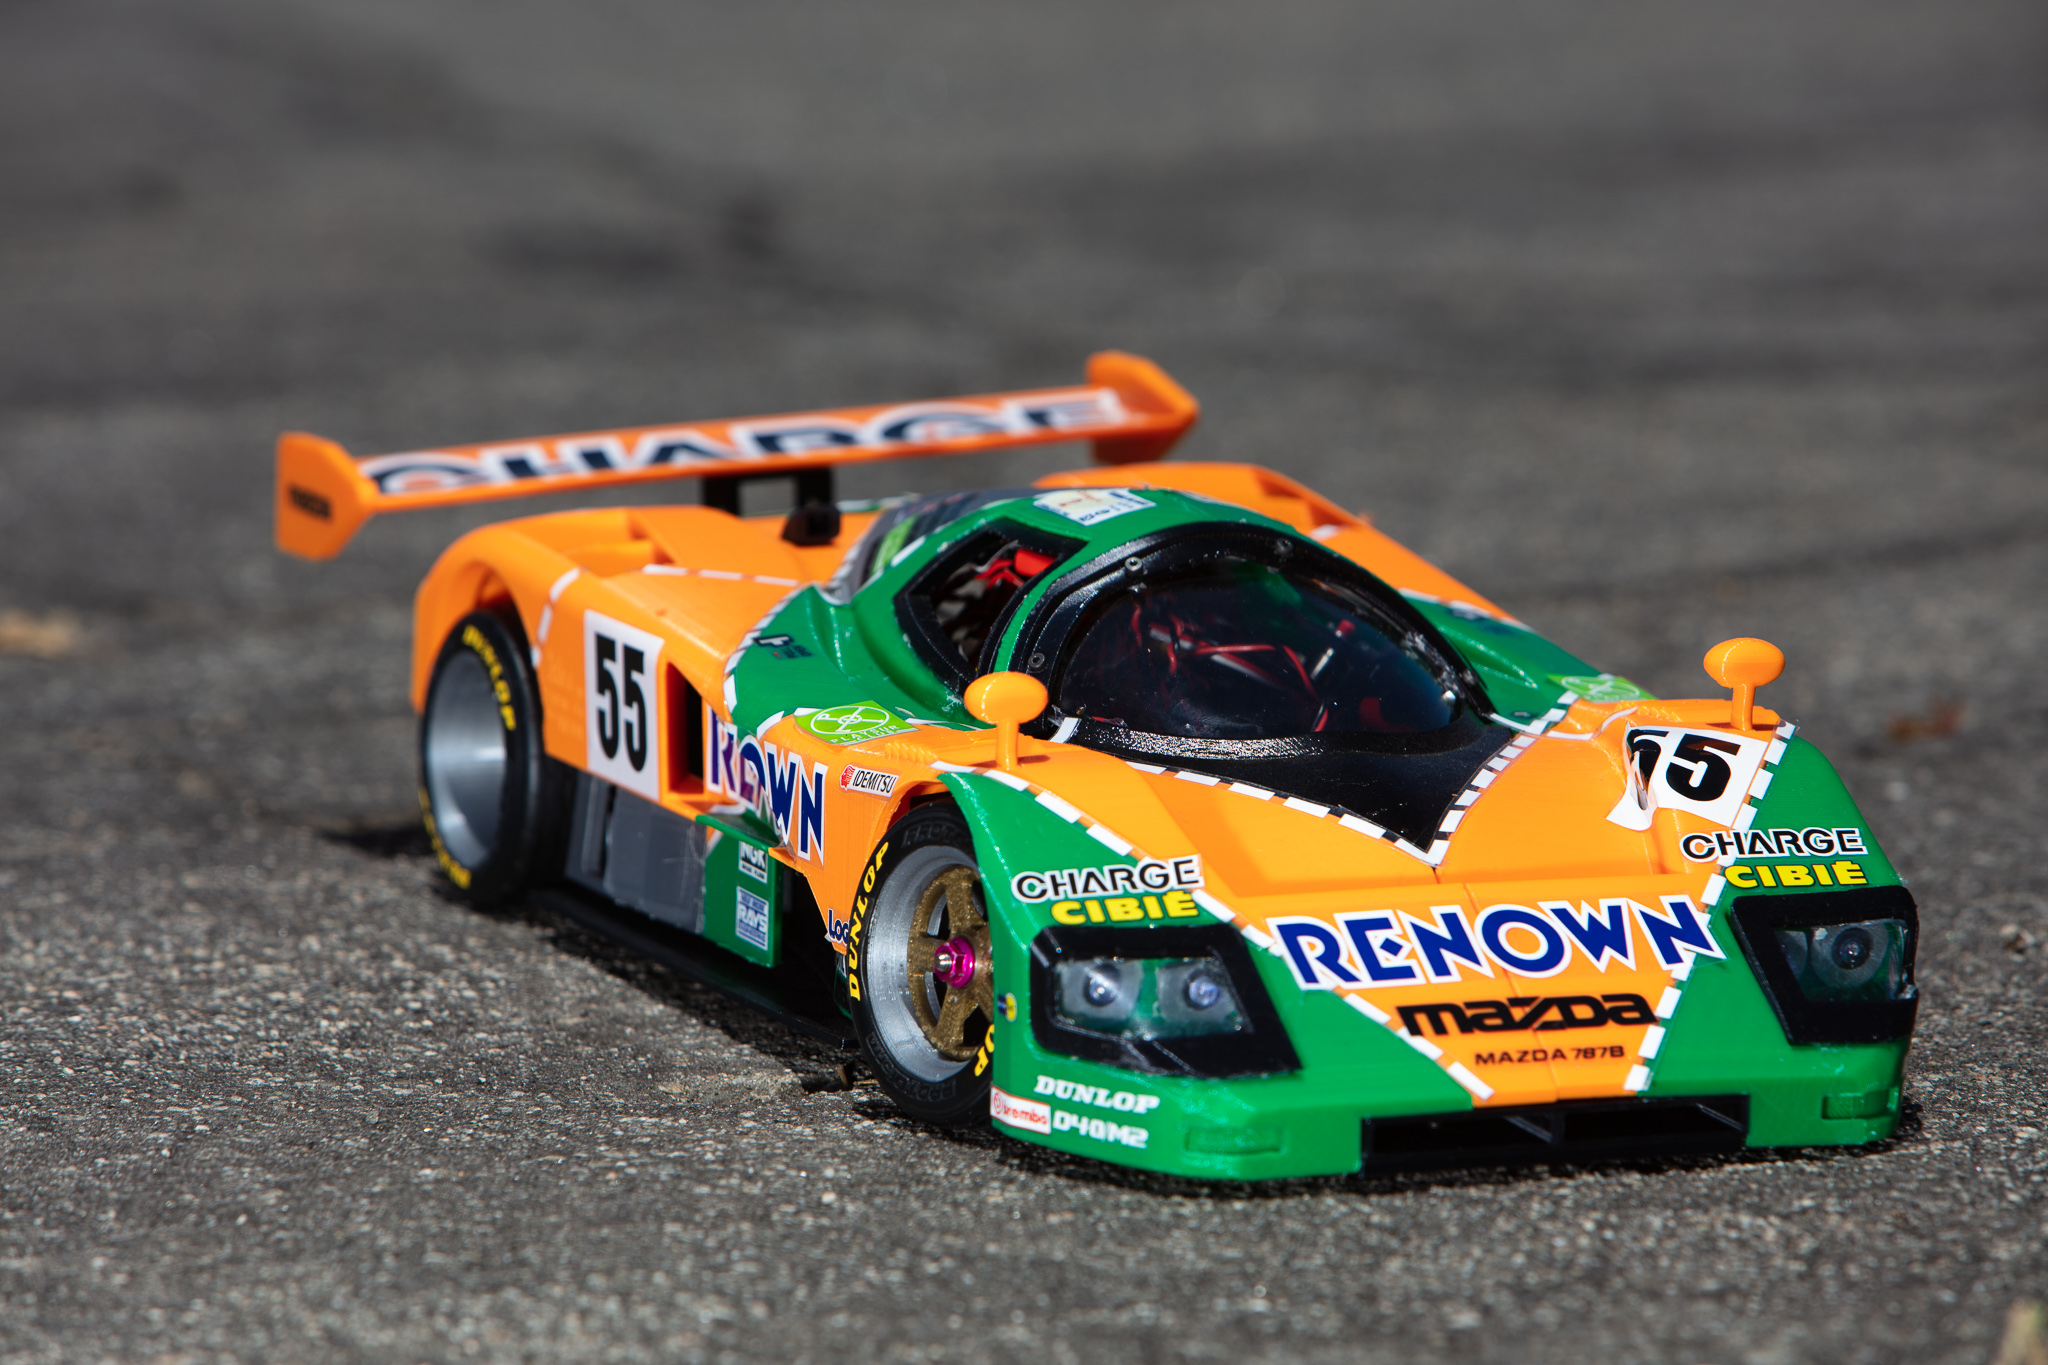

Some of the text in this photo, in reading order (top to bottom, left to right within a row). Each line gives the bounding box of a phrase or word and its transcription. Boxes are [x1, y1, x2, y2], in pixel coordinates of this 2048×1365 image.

[594, 632, 648, 772] 55
[852, 769, 897, 793] IDEMITSU
[741, 840, 767, 871] NGK
[1679, 826, 1869, 864] CHARGE
[1011, 854, 1205, 903] CHARGE
[738, 903, 768, 934] RAYS
[849, 841, 889, 1002] DUNLOP
[1266, 895, 1727, 990] RENOWN
[1475, 1045, 1626, 1067] MAZDA 787B
[1033, 1074, 1160, 1115] DUNLOP
